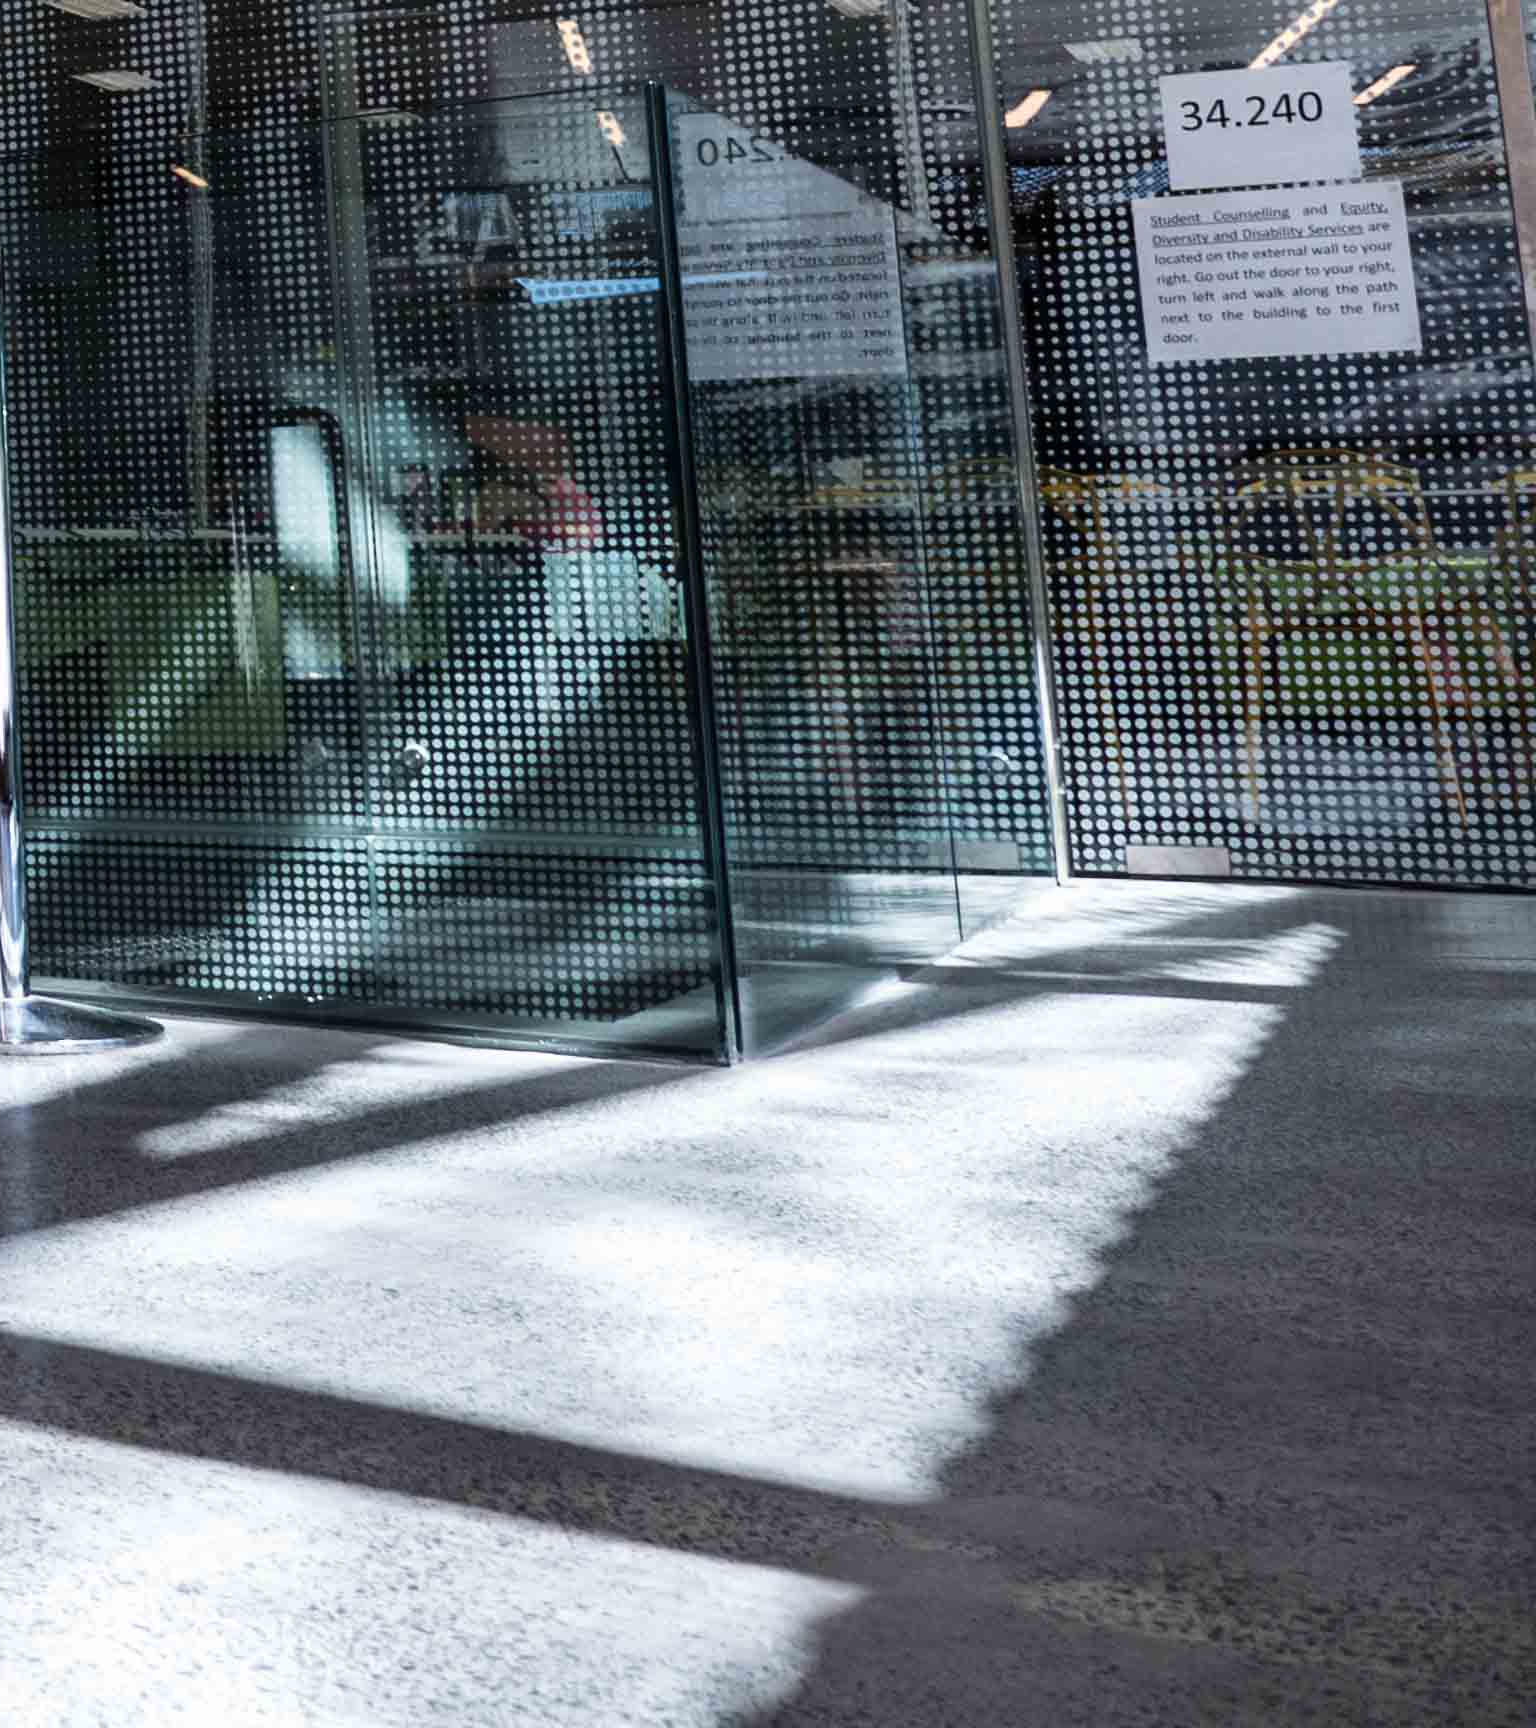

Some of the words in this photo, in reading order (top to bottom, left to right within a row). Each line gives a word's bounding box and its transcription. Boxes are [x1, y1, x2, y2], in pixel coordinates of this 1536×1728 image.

[1180, 91, 1323, 131] 34.240
[1150, 212, 1200, 226] Student
[1213, 207, 1289, 223] Counselling
[1303, 204, 1327, 216] and
[1152, 233, 1212, 248] Diversity
[1213, 229, 1238, 241] and
[1243, 225, 1303, 241] Disability
[1307, 222, 1363, 235] Services
[1368, 222, 1390, 232] are
[1155, 253, 1203, 265] located
[1206, 251, 1222, 261] on
[1225, 248, 1249, 260] the
[1252, 246, 1307, 259] external
[1311, 244, 1338, 256] wall
[1343, 243, 1358, 254] to
[1362, 242, 1392, 258] your
[1195, 271, 1213, 282] Go
[1217, 270, 1239, 281] out
[1243, 268, 1265, 279] the
[1269, 265, 1302, 278] door
[1305, 265, 1320, 276] to
[1324, 265, 1354, 281] your
[1159, 293, 1186, 305] turn
[1193, 291, 1215, 303] left
[1222, 289, 1247, 301] and
[1254, 287, 1284, 299] walk
[1292, 285, 1328, 299] along
[1336, 283, 1358, 294] the
[1365, 281, 1398, 296] path
[1161, 313, 1190, 324] next
[1198, 311, 1213, 322] to
[1222, 309, 1244, 321] the
[1253, 306, 1307, 320] building
[1316, 305, 1331, 315] to
[1340, 303, 1363, 314] the
[1372, 300, 1400, 313] first
[1163, 332, 1198, 345] door.
